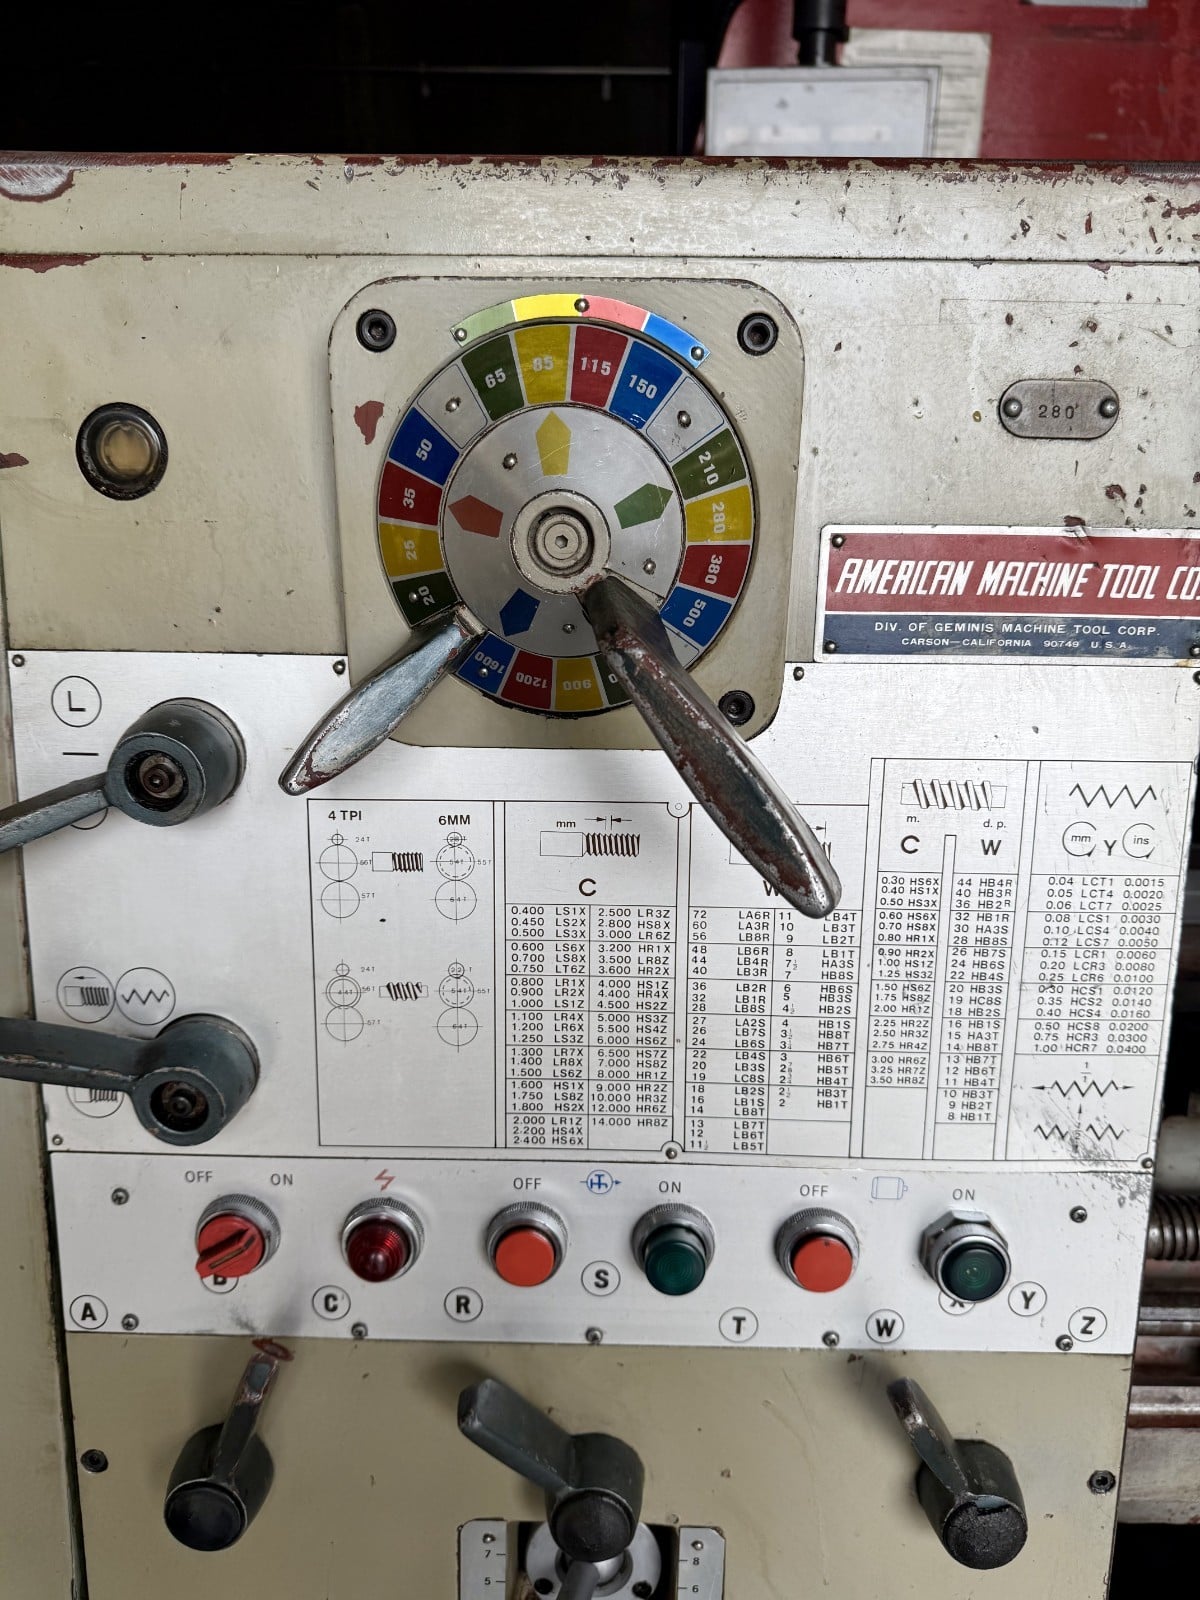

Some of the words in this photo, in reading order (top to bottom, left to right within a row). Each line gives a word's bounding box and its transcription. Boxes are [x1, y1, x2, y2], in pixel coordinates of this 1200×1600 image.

[532, 356, 554, 372] 85
[581, 357, 611, 376] 115
[485, 368, 506, 389] 65
[629, 374, 657, 399] 150
[416, 439, 433, 461] 50
[698, 451, 719, 485] 210
[403, 487, 416, 509] 35
[712, 502, 725, 534] 280
[406, 540, 417, 561] 25
[835, 558, 974, 595] AMERICAN
[976, 561, 1093, 598] MACHINE
[1097, 564, 1160, 600] TOOL
[418, 585, 435, 606] 20
[683, 599, 706, 627] 500
[908, 623, 926, 632] OF
[934, 623, 994, 633] GEMINIS
[1002, 623, 1066, 634] MACHINE
[1073, 625, 1108, 635] TOOL
[1117, 626, 1160, 636] CORP.
[1043, 640, 1079, 648] 90749
[516, 672, 548, 689] 1200
[563, 679, 592, 691] 900
[68, 691, 86, 712] L
[328, 811, 336, 820] 4
[340, 810, 362, 820] TPI
[439, 814, 471, 825] 6MM
[556, 820, 576, 828] mm
[1071, 834, 1091, 843] mm
[1133, 835, 1149, 845] ins
[900, 835, 920, 854] C
[981, 839, 1002, 855] W
[1104, 840, 1117, 856] Y
[882, 876, 905, 885] 0.30
[910, 878, 939, 886] HS6X
[980, 878, 1012, 887] HB4R
[1048, 877, 1074, 886] 0.04
[1082, 878, 1113, 886] LCT1
[1125, 879, 1164, 887] 0.0015
[578, 878, 597, 897] C
[1047, 889, 1073, 898] 0.05
[1081, 890, 1114, 898] LCT4
[1123, 891, 1163, 899] 0.0020
[880, 898, 903, 906] 0.50
[908, 899, 937, 907] HS3X
[1046, 901, 1071, 910] 0.06
[1080, 902, 1112, 911] LCT7
[1122, 903, 1162, 911] 0.0025
[512, 906, 544, 915] 0.400
[556, 907, 586, 915] LS1X
[693, 910, 707, 919] 72
[739, 911, 770, 920] LA6R
[908, 912, 936, 921] HS6X
[955, 913, 970, 921] 32
[977, 913, 1009, 922] HB1R
[1045, 914, 1070, 923] 0.08
[1079, 915, 1110, 923] LCS1
[1121, 915, 1160, 924] 0.0030
[693, 922, 707, 930] 60
[739, 922, 770, 930] LA3R
[780, 923, 794, 931] 10
[823, 924, 856, 933] LB3T
[879, 922, 901, 930] 0.70
[907, 923, 936, 931] HS8X
[954, 924, 969, 933] 30
[976, 925, 1009, 934] HA3S
[512, 928, 544, 937] 0.500
[556, 929, 586, 938] LS3X
[739, 933, 770, 942] LB8R
[822, 936, 855, 944] LB2T
[511, 943, 544, 951] 0.600
[555, 944, 585, 952] LS6X
[692, 946, 707, 954] 48
[738, 947, 769, 956] LB6R
[822, 950, 855, 959] LB1T
[1041, 950, 1066, 958] 0.15
[1075, 951, 1105, 959] LCR1
[1116, 951, 1156, 959] 0.0060
[692, 956, 707, 964] 44
[737, 957, 768, 967] LB4R
[511, 965, 544, 973] 0.750
[556, 965, 585, 974] LT6Z
[692, 967, 707, 975] 40
[737, 968, 767, 976] LB3R
[821, 972, 854, 980] HB8S
[511, 978, 544, 986] 0.800
[555, 979, 585, 987] LR1X
[821, 985, 853, 993] HB6S
[512, 1000, 543, 1008] 1.000
[555, 1000, 584, 1008] LS1Z
[512, 1013, 543, 1021] 1.100
[554, 1013, 584, 1021] LR4X
[1035, 1022, 1060, 1031] 0.50
[1067, 1022, 1100, 1031] HCS8
[1109, 1023, 1148, 1031] 0.0200
[512, 1035, 543, 1043] 1.250
[554, 1035, 584, 1043] LS3Z
[512, 1048, 543, 1056] 1.300
[554, 1048, 584, 1057] LR7X
[511, 1069, 542, 1077] 1.500
[553, 1070, 582, 1078] LS6Z
[512, 1081, 543, 1089] 1.600
[554, 1082, 584, 1090] HS1X
[512, 1103, 543, 1111] 1.800
[555, 1104, 585, 1112] HS2X
[513, 1116, 545, 1125] 2.000
[552, 1117, 582, 1125] LR1Z
[513, 1127, 545, 1135] 2.200
[552, 1127, 583, 1135] HS4X
[513, 1136, 545, 1145] 2.400
[552, 1137, 584, 1145] HS6X
[185, 1170, 213, 1184] OFF
[271, 1173, 293, 1187] ON
[513, 1177, 542, 1190] OFF
[659, 1180, 682, 1194] ON
[800, 1184, 829, 1197] OFF
[953, 1188, 976, 1201] ON
[595, 1269, 609, 1289] S
[325, 1294, 338, 1313] C
[456, 1296, 471, 1314] R
[1020, 1291, 1037, 1310] Y
[80, 1303, 97, 1322] A
[732, 1317, 746, 1335] T
[875, 1318, 896, 1336] W
[1081, 1316, 1095, 1335] Z
[485, 1550, 491, 1558] 7
[693, 1557, 700, 1565] 8
[485, 1578, 491, 1586] 5
[692, 1585, 699, 1593] 6
